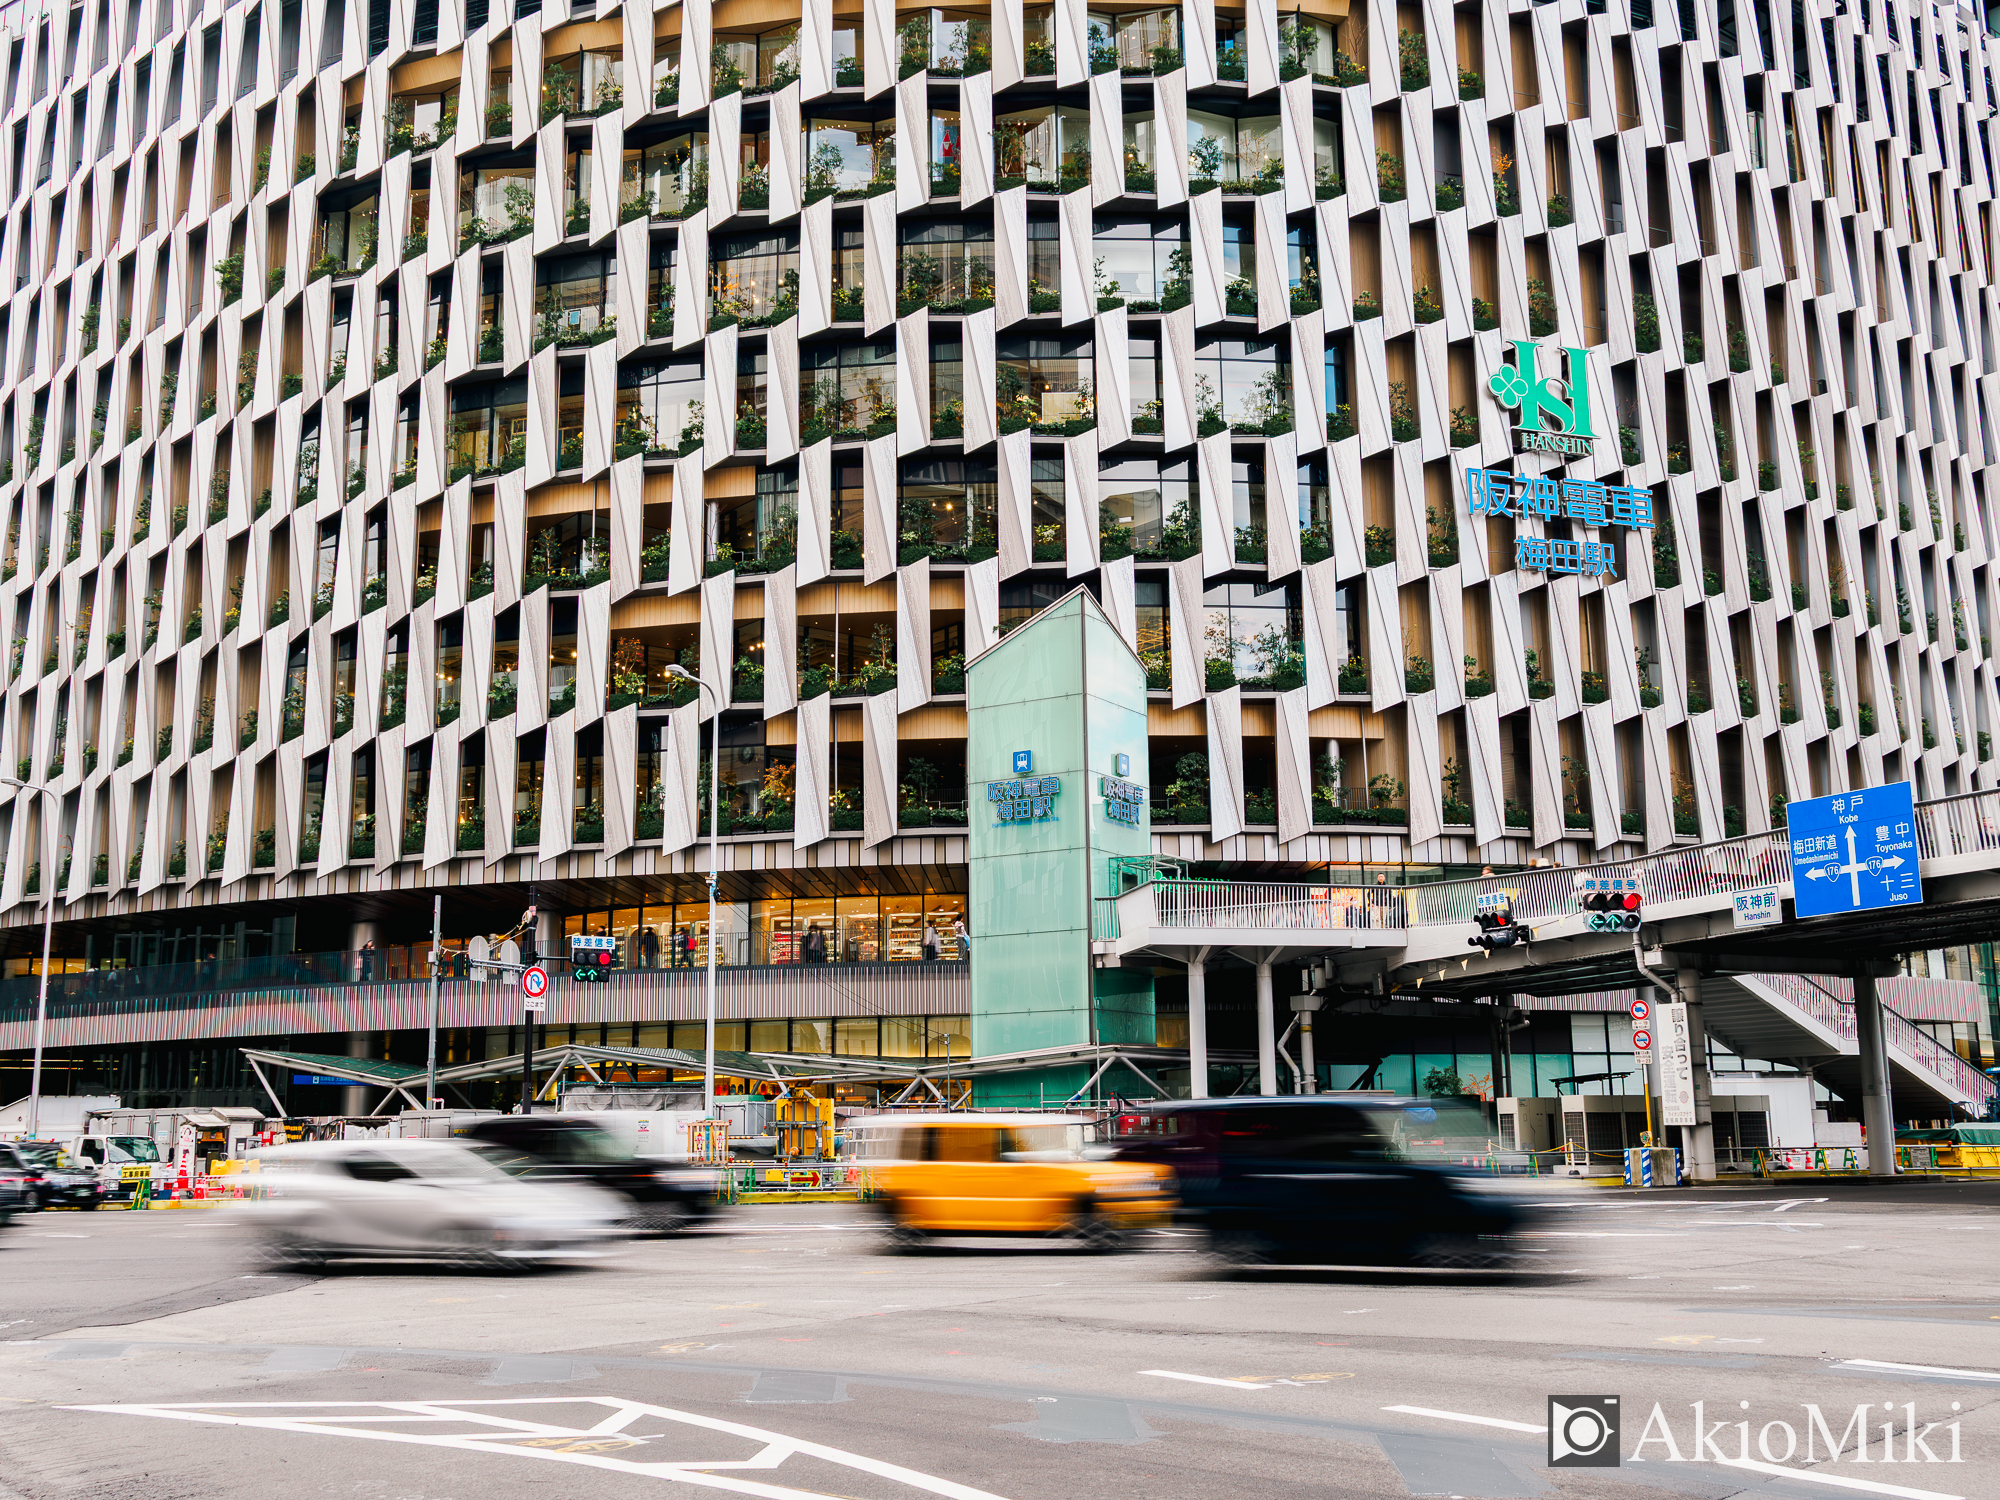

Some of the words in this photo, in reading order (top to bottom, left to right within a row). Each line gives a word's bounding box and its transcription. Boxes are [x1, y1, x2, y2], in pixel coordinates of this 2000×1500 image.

[1522, 433, 1594, 455] HANSHIN
[1465, 467, 1655, 530] 阪神電車
[1514, 535, 1618, 577] 梅田駅
[987, 776, 1060, 802] 阪神電車
[1104, 777, 1143, 804] 阪神電車
[996, 796, 1052, 821] 梅田駅
[1110, 798, 1140, 825] 梅田駅
[1831, 794, 1864, 815] 神戸
[1839, 814, 1859, 824] Kobe
[1875, 821, 1910, 842] 豊中
[1793, 834, 1838, 855] 梅田新道
[1875, 840, 1913, 853] Toyonaka
[1793, 851, 1839, 866] Umedashimmichi
[1868, 859, 1881, 870] 176
[1826, 867, 1839, 876] 176
[1585, 879, 1637, 891] 時差信号
[1880, 872, 1915, 892] 十三
[1735, 891, 1777, 911] 阪神前
[1889, 892, 1909, 902] Juso
[1744, 910, 1771, 922] Hanshin
[572, 936, 614, 948] 時差信号
[1661, 1045, 1678, 1104] 安全運転
